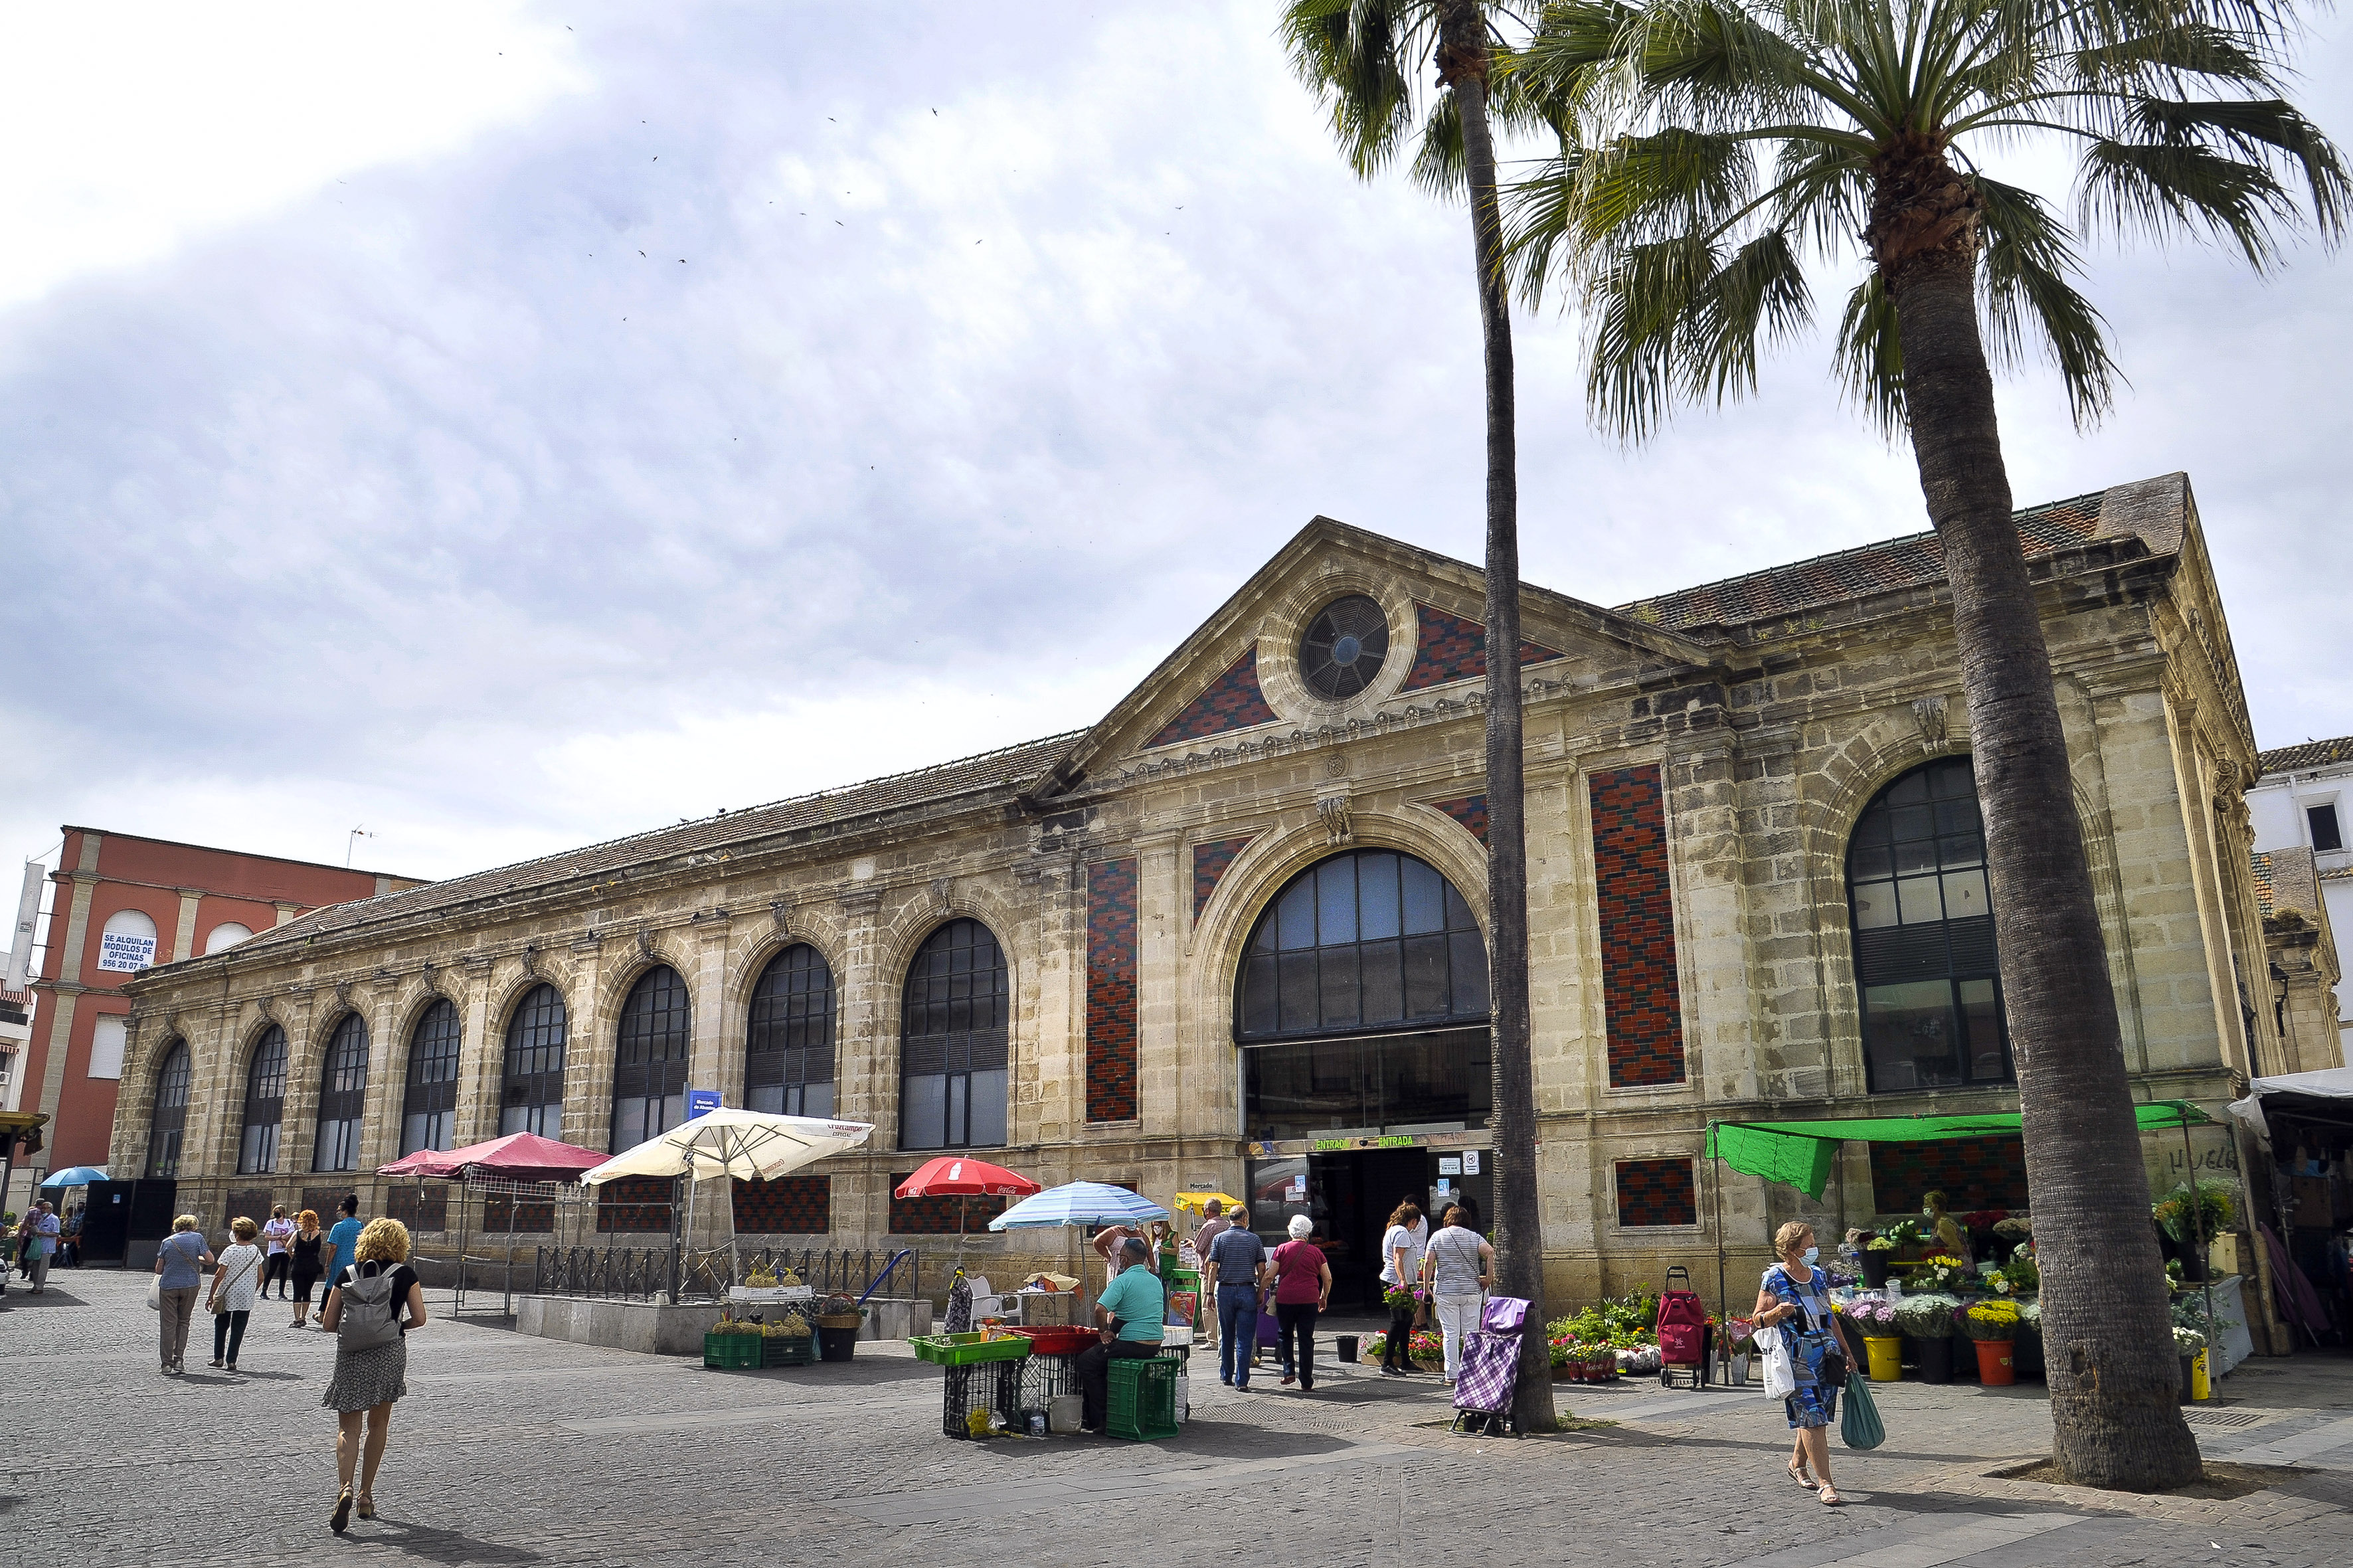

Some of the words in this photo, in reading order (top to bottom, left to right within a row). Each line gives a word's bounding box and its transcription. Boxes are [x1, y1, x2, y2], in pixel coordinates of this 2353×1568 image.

[116, 936, 153, 946] ALQUILAN
[104, 942, 140, 953] MODULOS
[109, 951, 144, 962] OFICINAS
[1379, 1135, 1413, 1147] ENTRADA
